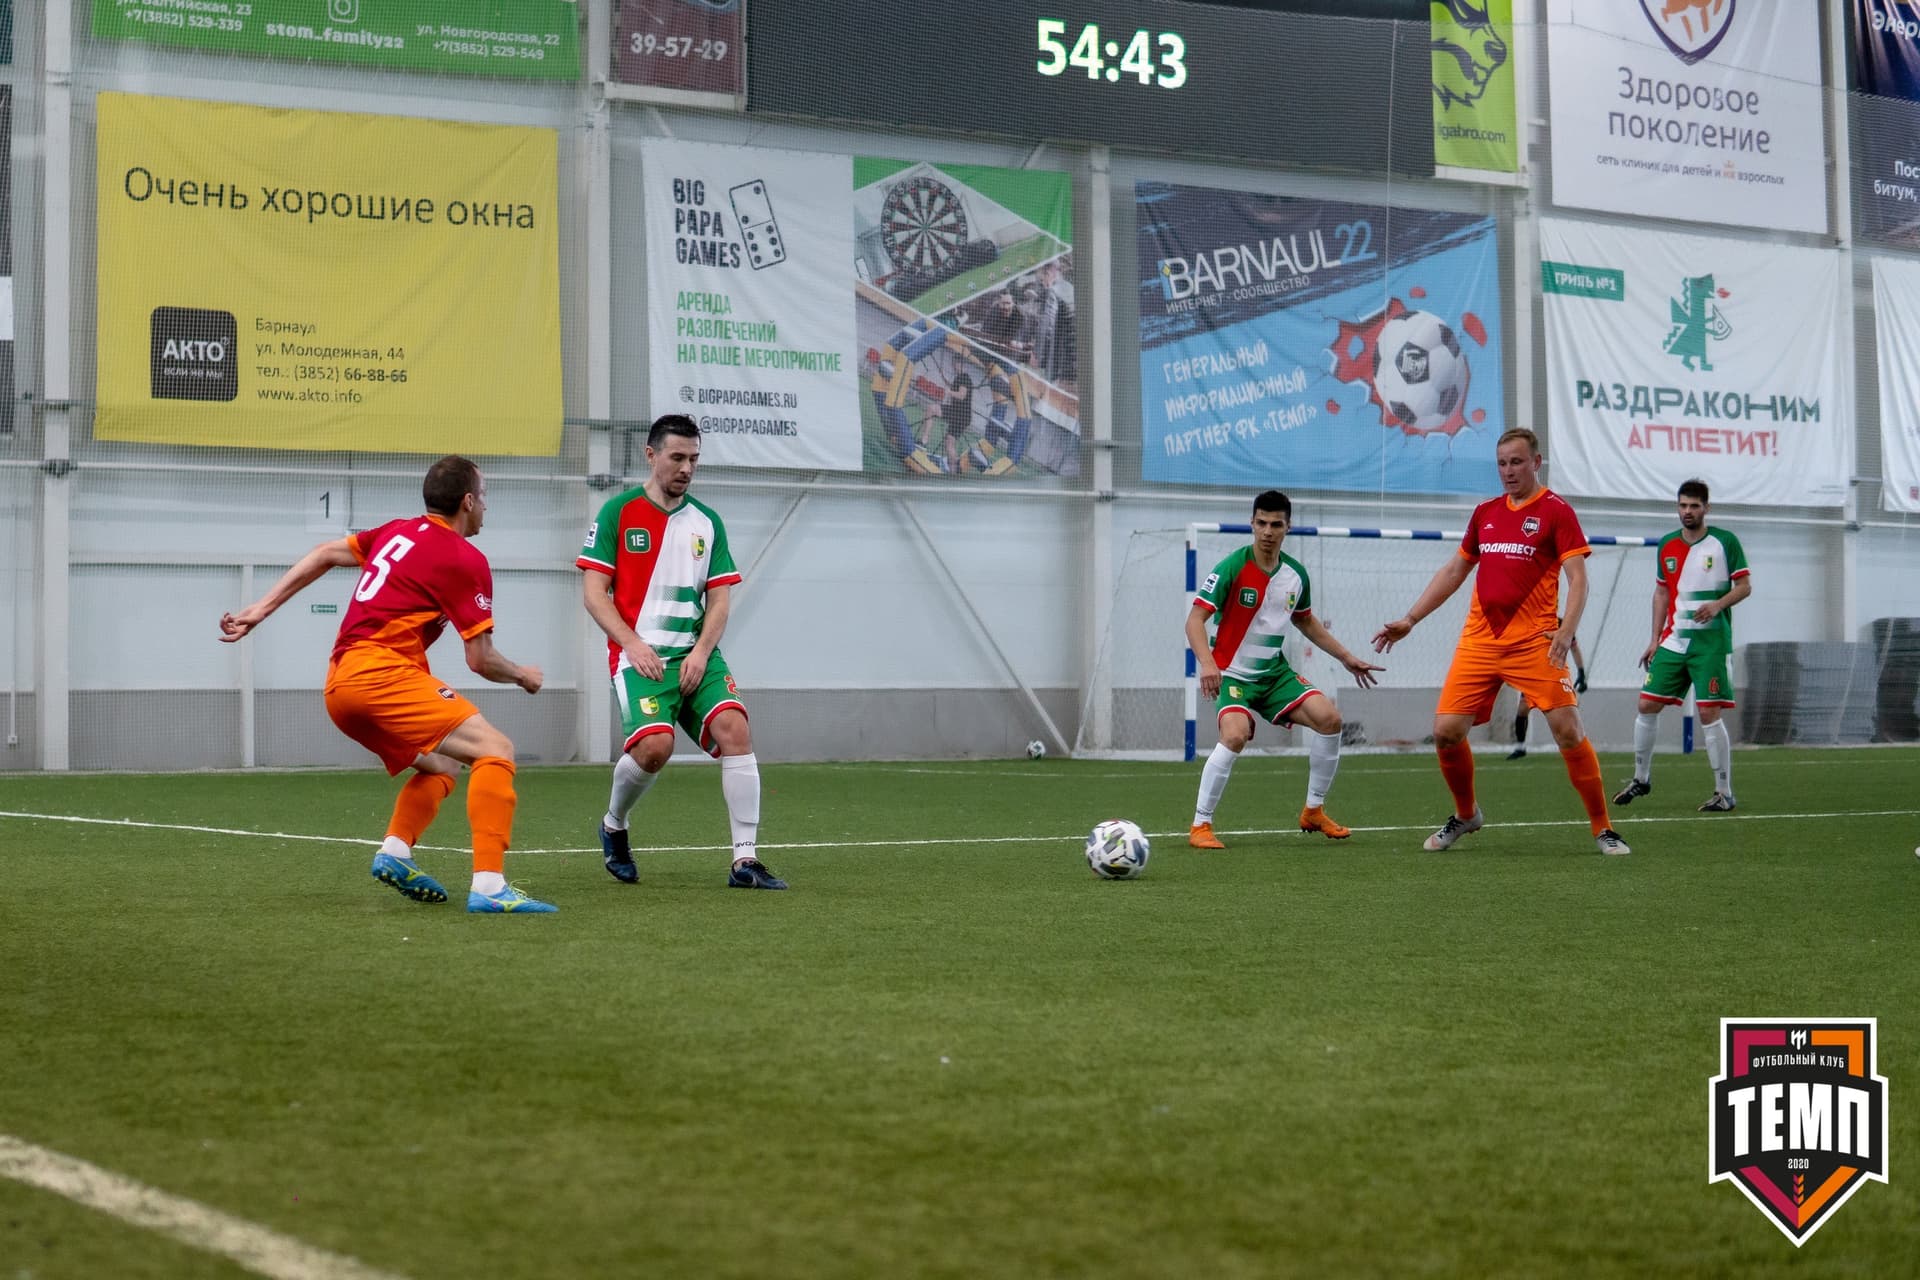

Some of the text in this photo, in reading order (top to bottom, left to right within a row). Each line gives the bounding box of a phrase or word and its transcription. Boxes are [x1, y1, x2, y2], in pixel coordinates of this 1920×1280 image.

[125, 8, 243, 31] +7(3852) 529-339
[236, 4, 252, 15] 23
[266, 23, 404, 49] stom_family22
[440, 26, 542, 44] Новгородская,
[544, 34, 560, 45] 22
[1871, 10, 1920, 40] Энер
[433, 40, 545, 60] +7(3852) 529-549
[630, 32, 728, 61] 39-57-29
[1037, 19, 1187, 89] 54:43
[1618, 66, 1759, 115] Здоровое
[1608, 111, 1771, 154] поколение
[1596, 154, 1619, 166] сеть
[1621, 158, 1660, 172] клиник
[1682, 164, 1713, 178] детей
[1737, 171, 1785, 185] взрослых
[1894, 160, 1920, 178] Пос
[124, 166, 535, 230] Очень хорошие окна
[673, 177, 705, 206] BIG
[1873, 179, 1917, 203] битум,
[674, 207, 725, 238] PAPA
[675, 237, 741, 269] GAMES
[676, 290, 732, 315] АРЕНДА
[1164, 296, 1225, 315] ИНТЕРНЕТ
[1233, 274, 1311, 303] СООБЩЕСТВО
[255, 318, 316, 335] Барнаул
[677, 317, 777, 343] РАЗВЛЕЧЕНИЙ
[163, 338, 225, 362] АКТО
[256, 343, 404, 362] ул. Молодежная, 44
[677, 343, 843, 373] НА ВАШЕ МЕРОПРИЯТИЕ
[1162, 338, 1269, 384] ГЕНЕРАЛЬНЫЙ
[294, 365, 340, 383] (3852)
[344, 367, 408, 383] 66-88-66
[258, 389, 363, 404] www.akto.info
[698, 388, 798, 408] BIGPAPAGAMES.RU
[1163, 368, 1308, 423] ИНФОРМАЦИОННЫЙ
[1576, 380, 1820, 422] РАЗДРАКОНИМ
[700, 416, 797, 437] @BIGPAPAGAMES
[1163, 404, 1318, 456] ПАРТНЕР ФК «ТЕМП»
[1628, 424, 1780, 457] АППЕТИТ!
[319, 491, 329, 518] 1
[631, 534, 645, 546] 1E
[355, 534, 416, 602] 5
[1243, 592, 1254, 603] 1E
